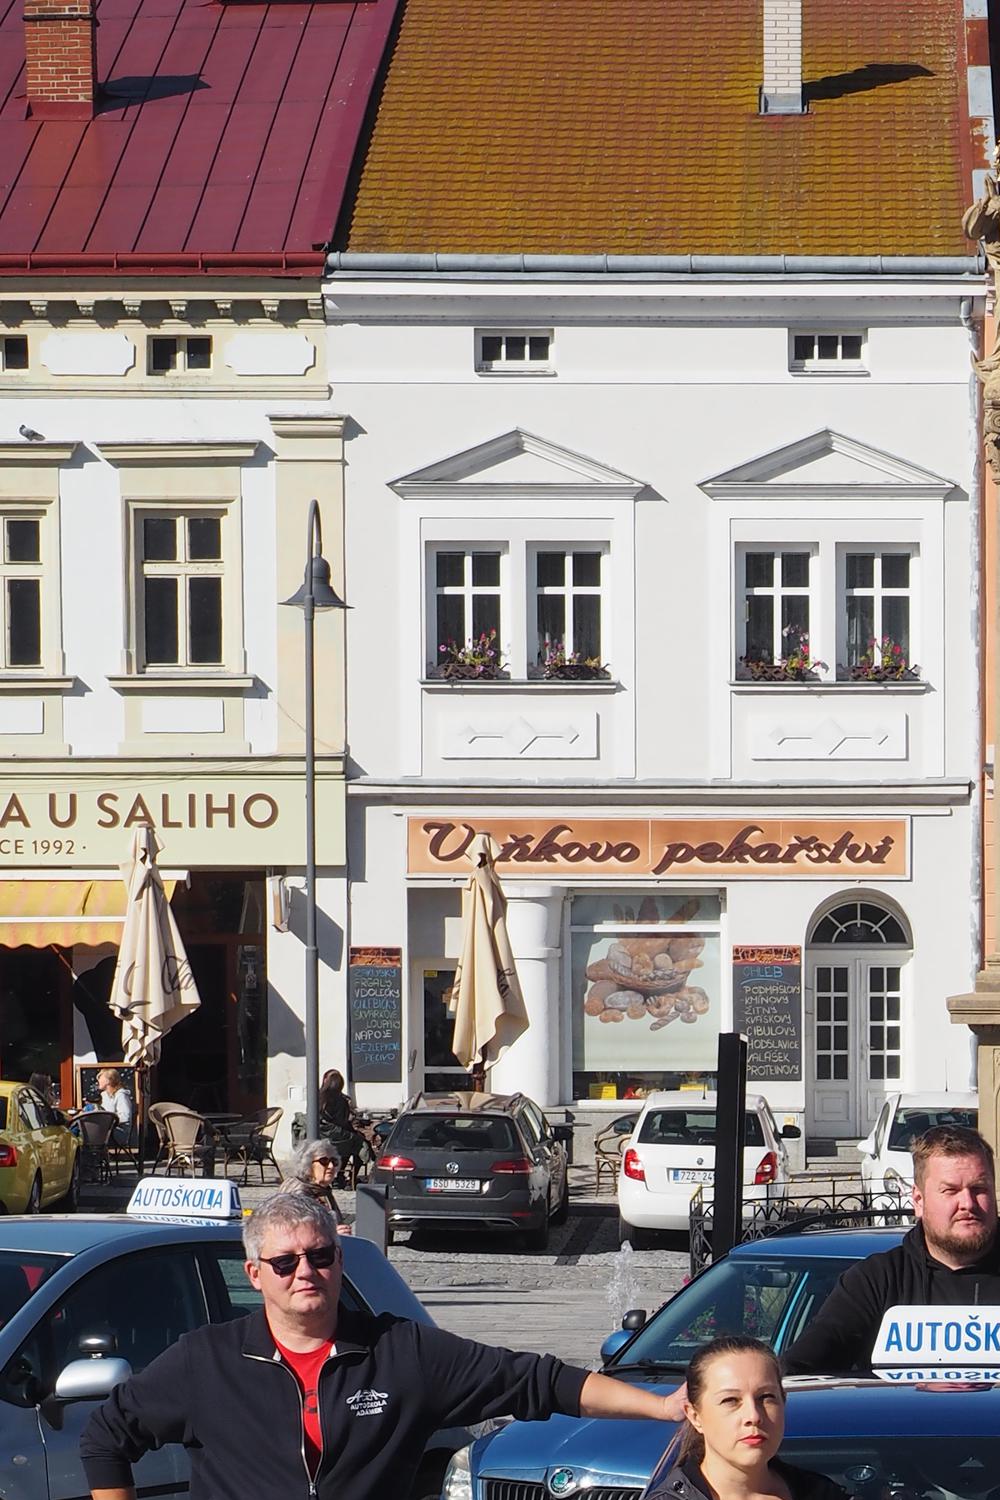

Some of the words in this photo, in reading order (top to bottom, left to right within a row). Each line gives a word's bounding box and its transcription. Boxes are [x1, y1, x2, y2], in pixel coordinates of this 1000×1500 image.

[49, 793, 78, 828] U
[97, 793, 279, 828] SALIHO
[32, 839, 75, 855] 1992
[422, 822, 641, 863] Vňkovo
[133, 1184, 223, 1210] AUTOŠKOLA
